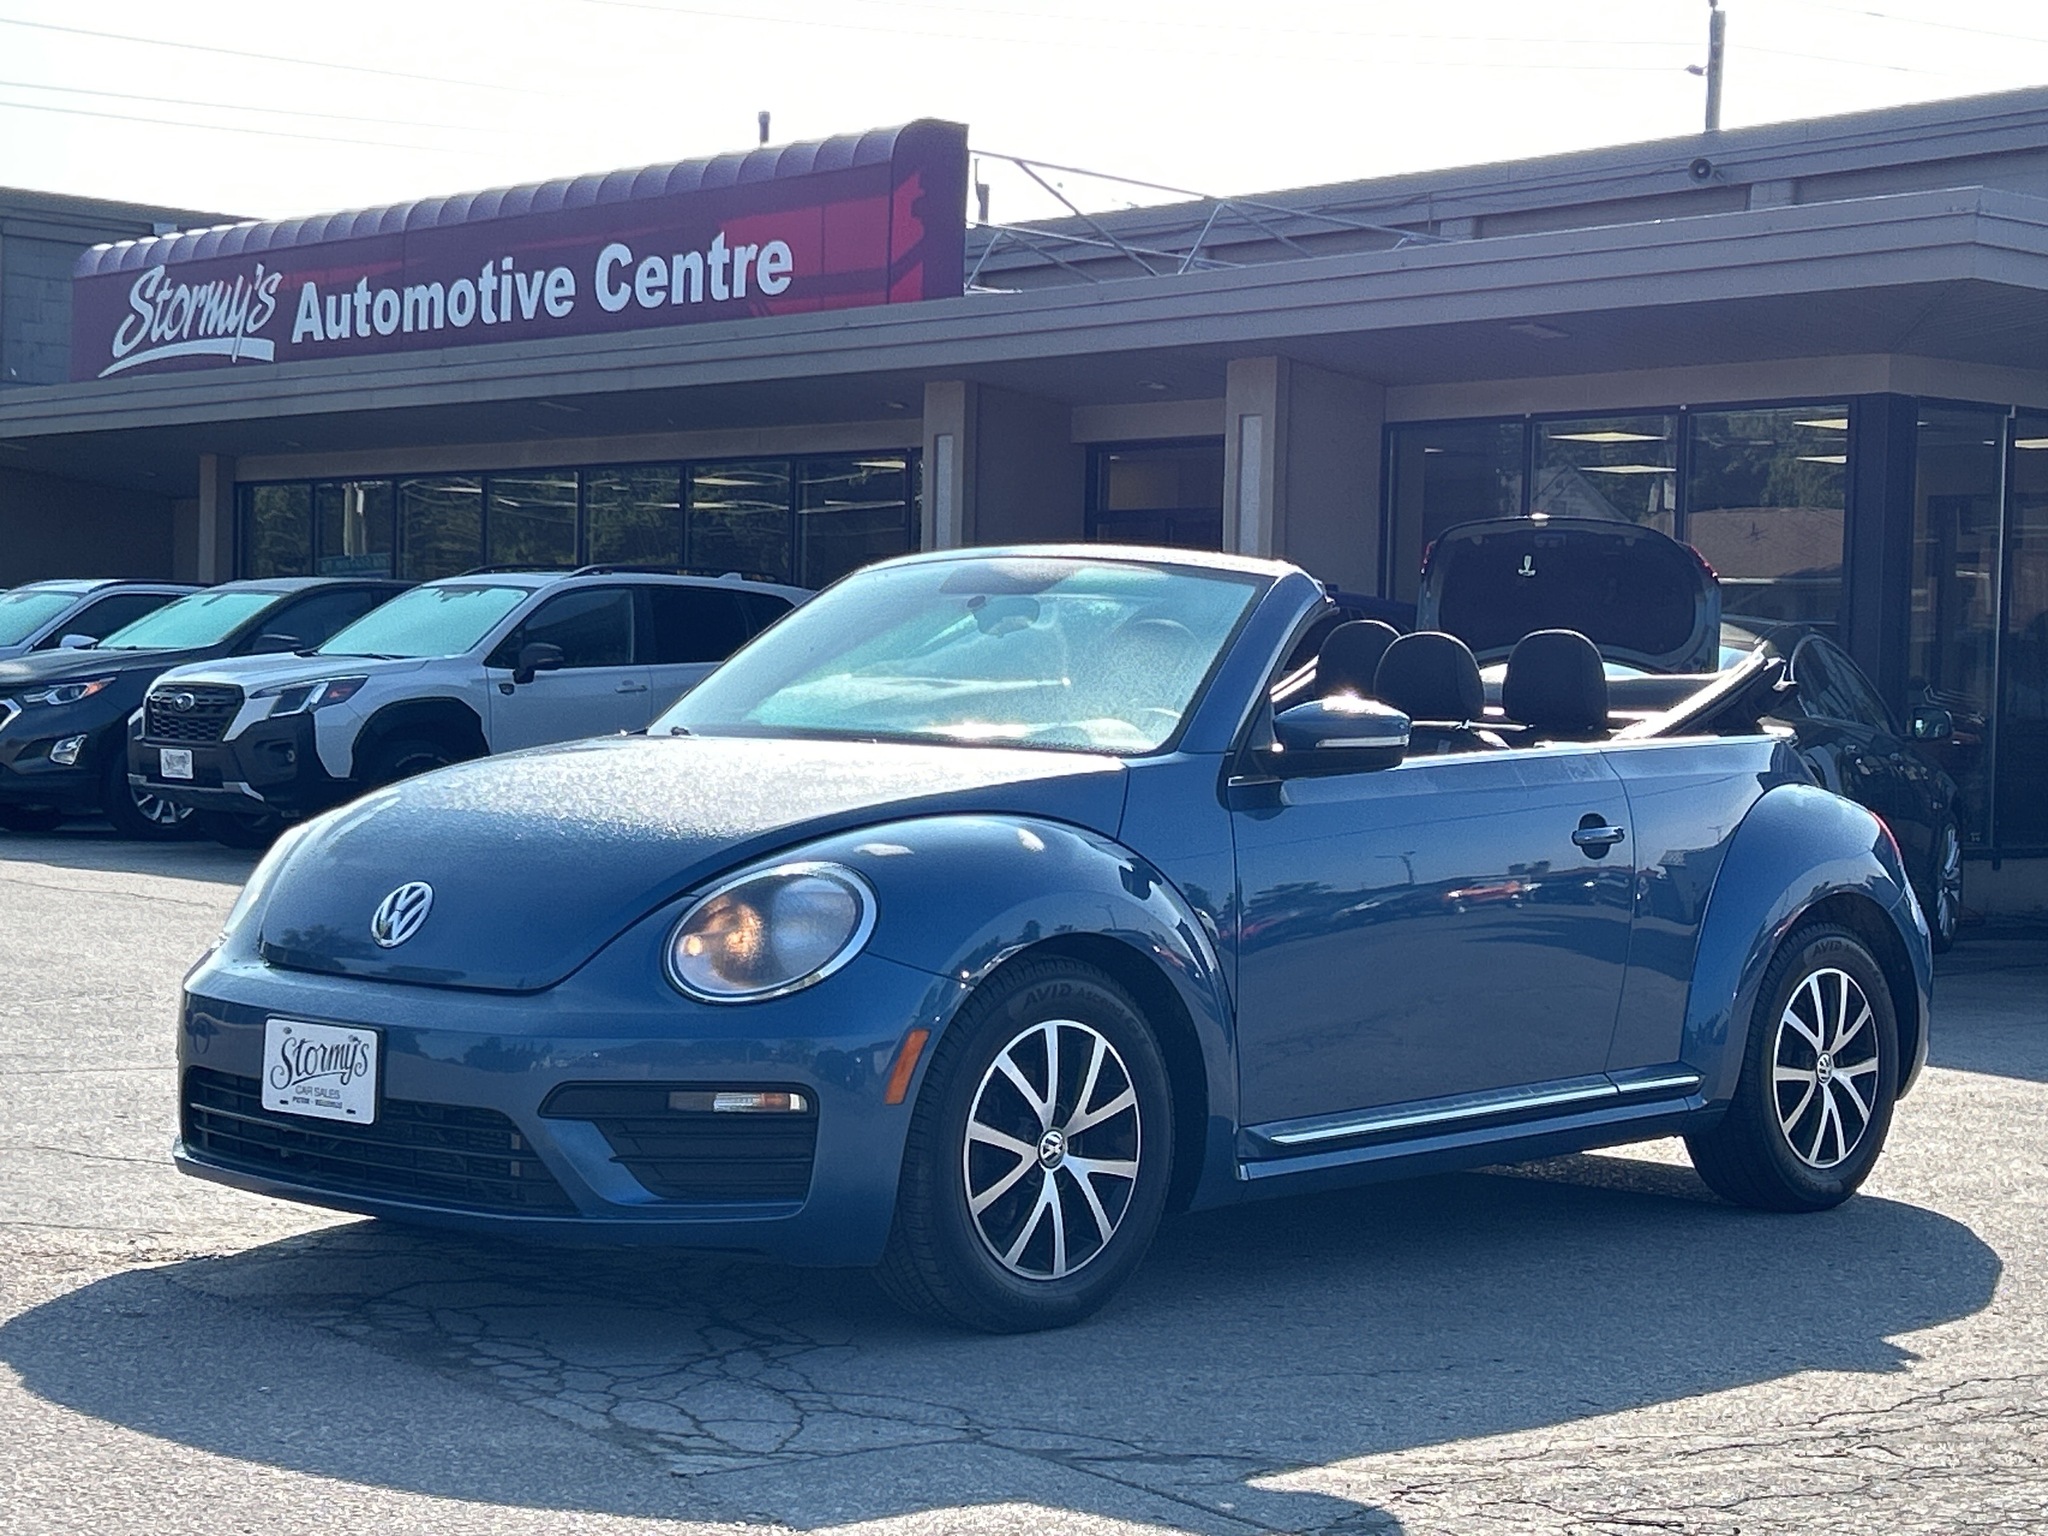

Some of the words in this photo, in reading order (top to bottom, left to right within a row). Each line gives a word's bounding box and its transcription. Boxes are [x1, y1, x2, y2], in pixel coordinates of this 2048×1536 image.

[111, 262, 283, 364] Stormy's
[291, 256, 576, 343] Automotive
[595, 231, 793, 312] Centre
[1023, 983, 1072, 1010] AVID
[270, 1036, 369, 1090] Stormy's
[295, 1085, 312, 1096] CAR
[314, 1087, 341, 1100] SALES
